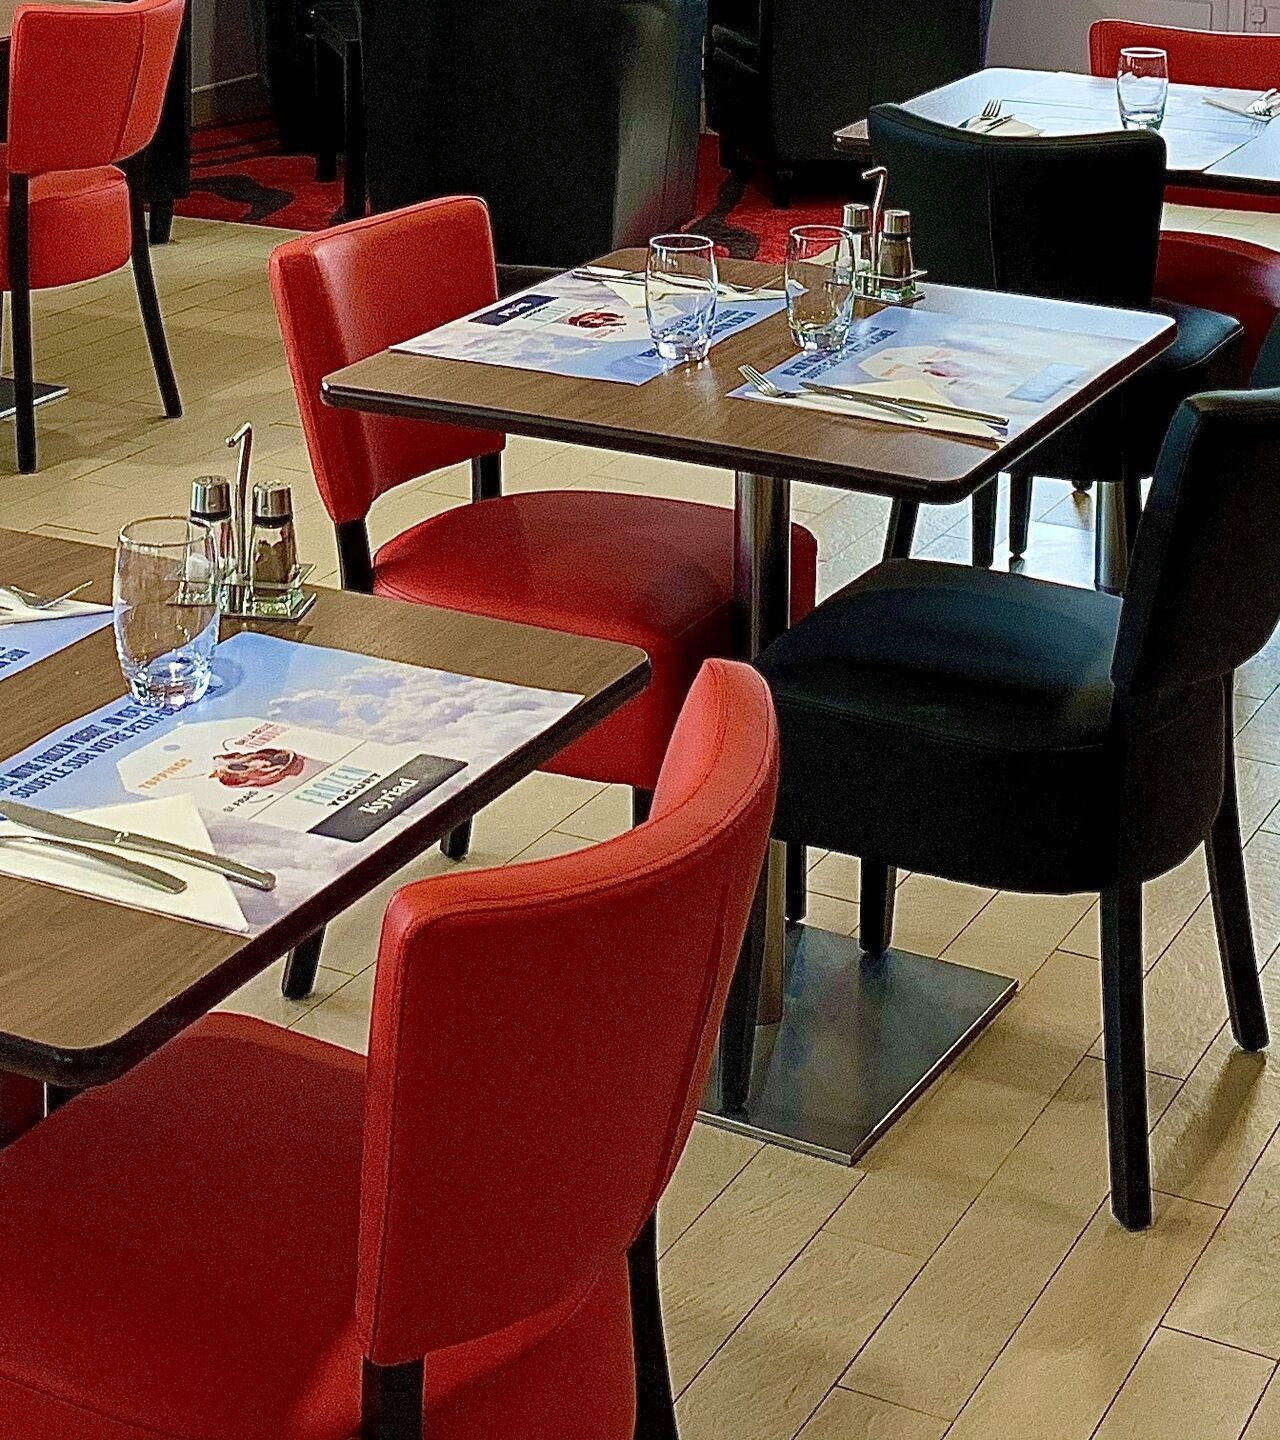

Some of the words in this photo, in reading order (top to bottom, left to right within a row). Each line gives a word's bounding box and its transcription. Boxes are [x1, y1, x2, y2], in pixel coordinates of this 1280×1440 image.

[10, 766, 74, 799] SOUFFLE
[68, 750, 99, 771] SUR
[88, 728, 134, 760] VOTRE
[326, 773, 382, 808] YOGURT
[358, 777, 420, 815] Kyriad
